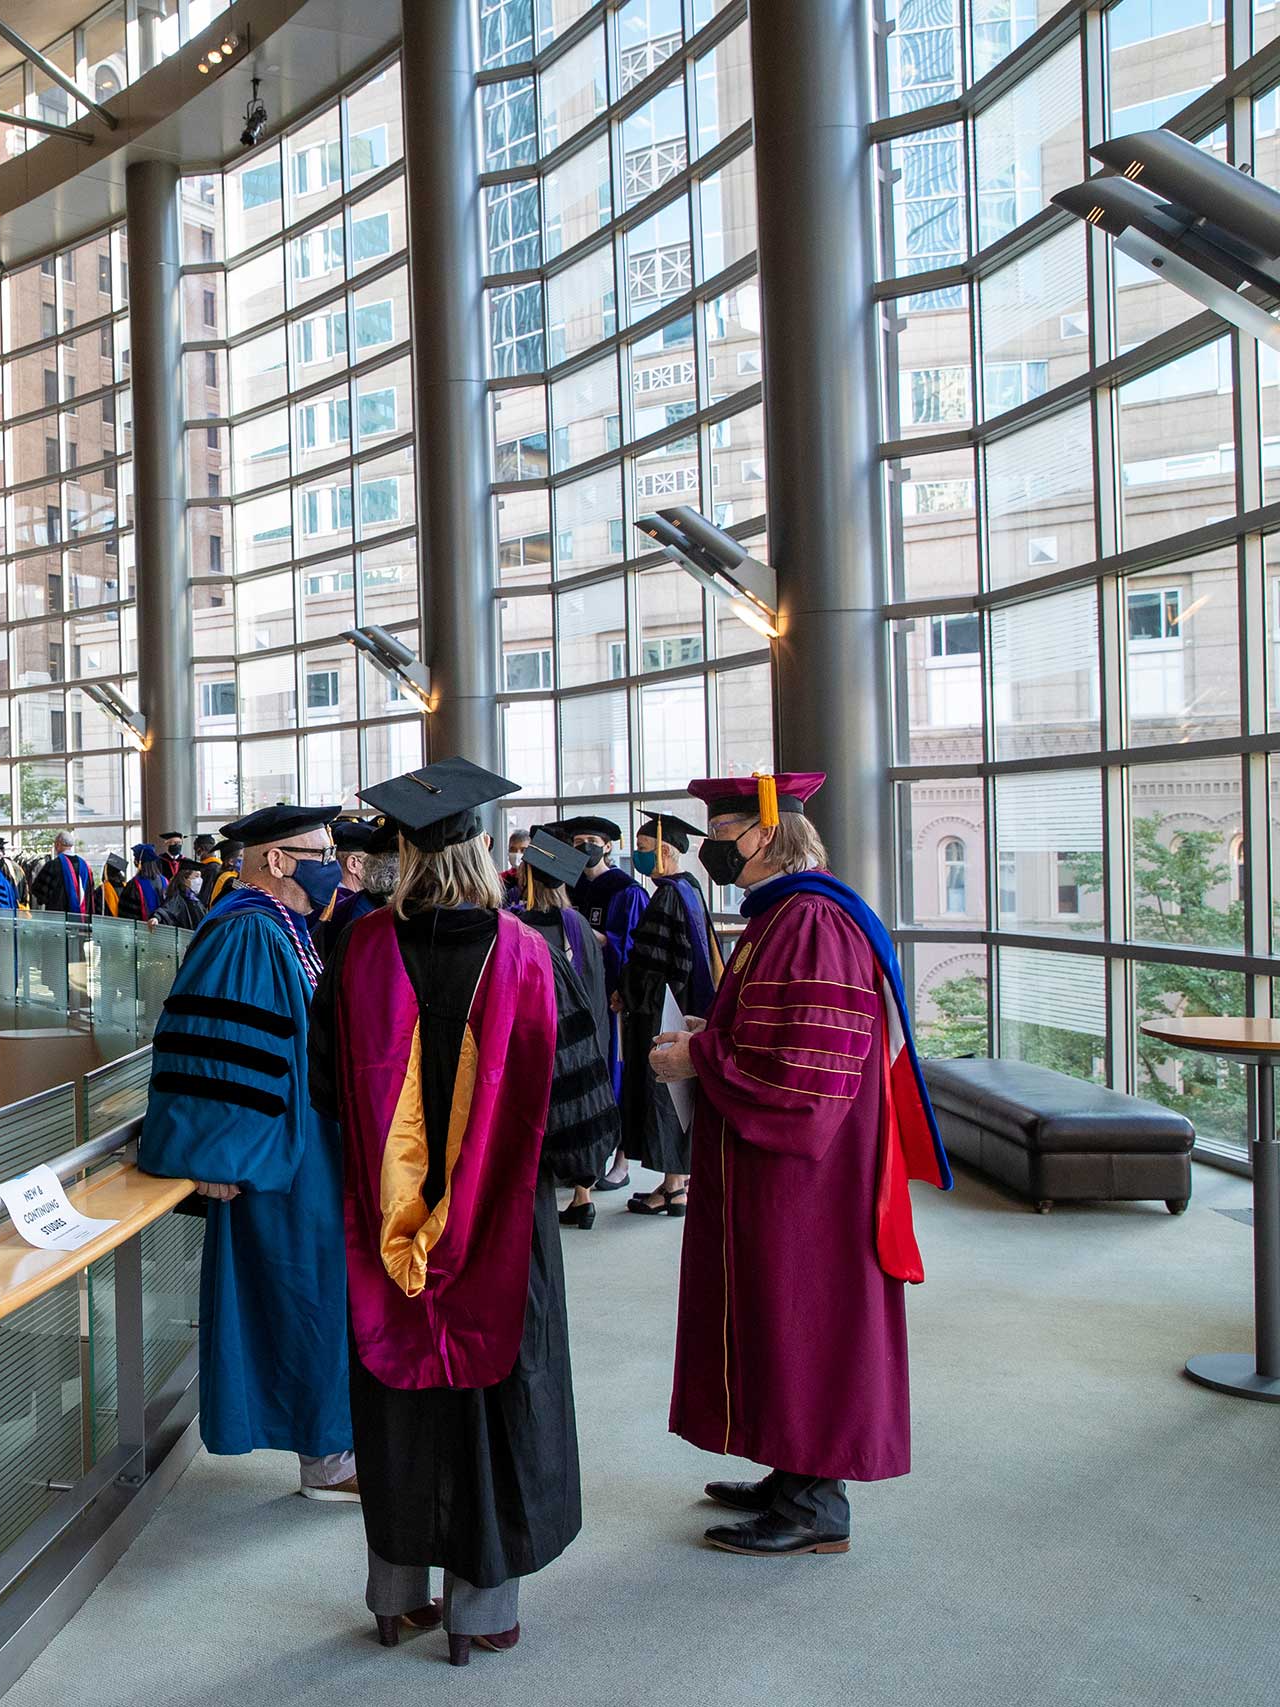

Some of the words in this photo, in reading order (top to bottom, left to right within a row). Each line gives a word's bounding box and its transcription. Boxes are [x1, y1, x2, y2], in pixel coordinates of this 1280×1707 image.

[23, 1187, 39, 1202] NEW
[36, 1186, 43, 1195] &
[23, 1198, 60, 1224] CONTINUING
[40, 1217, 67, 1236] STUDIES
